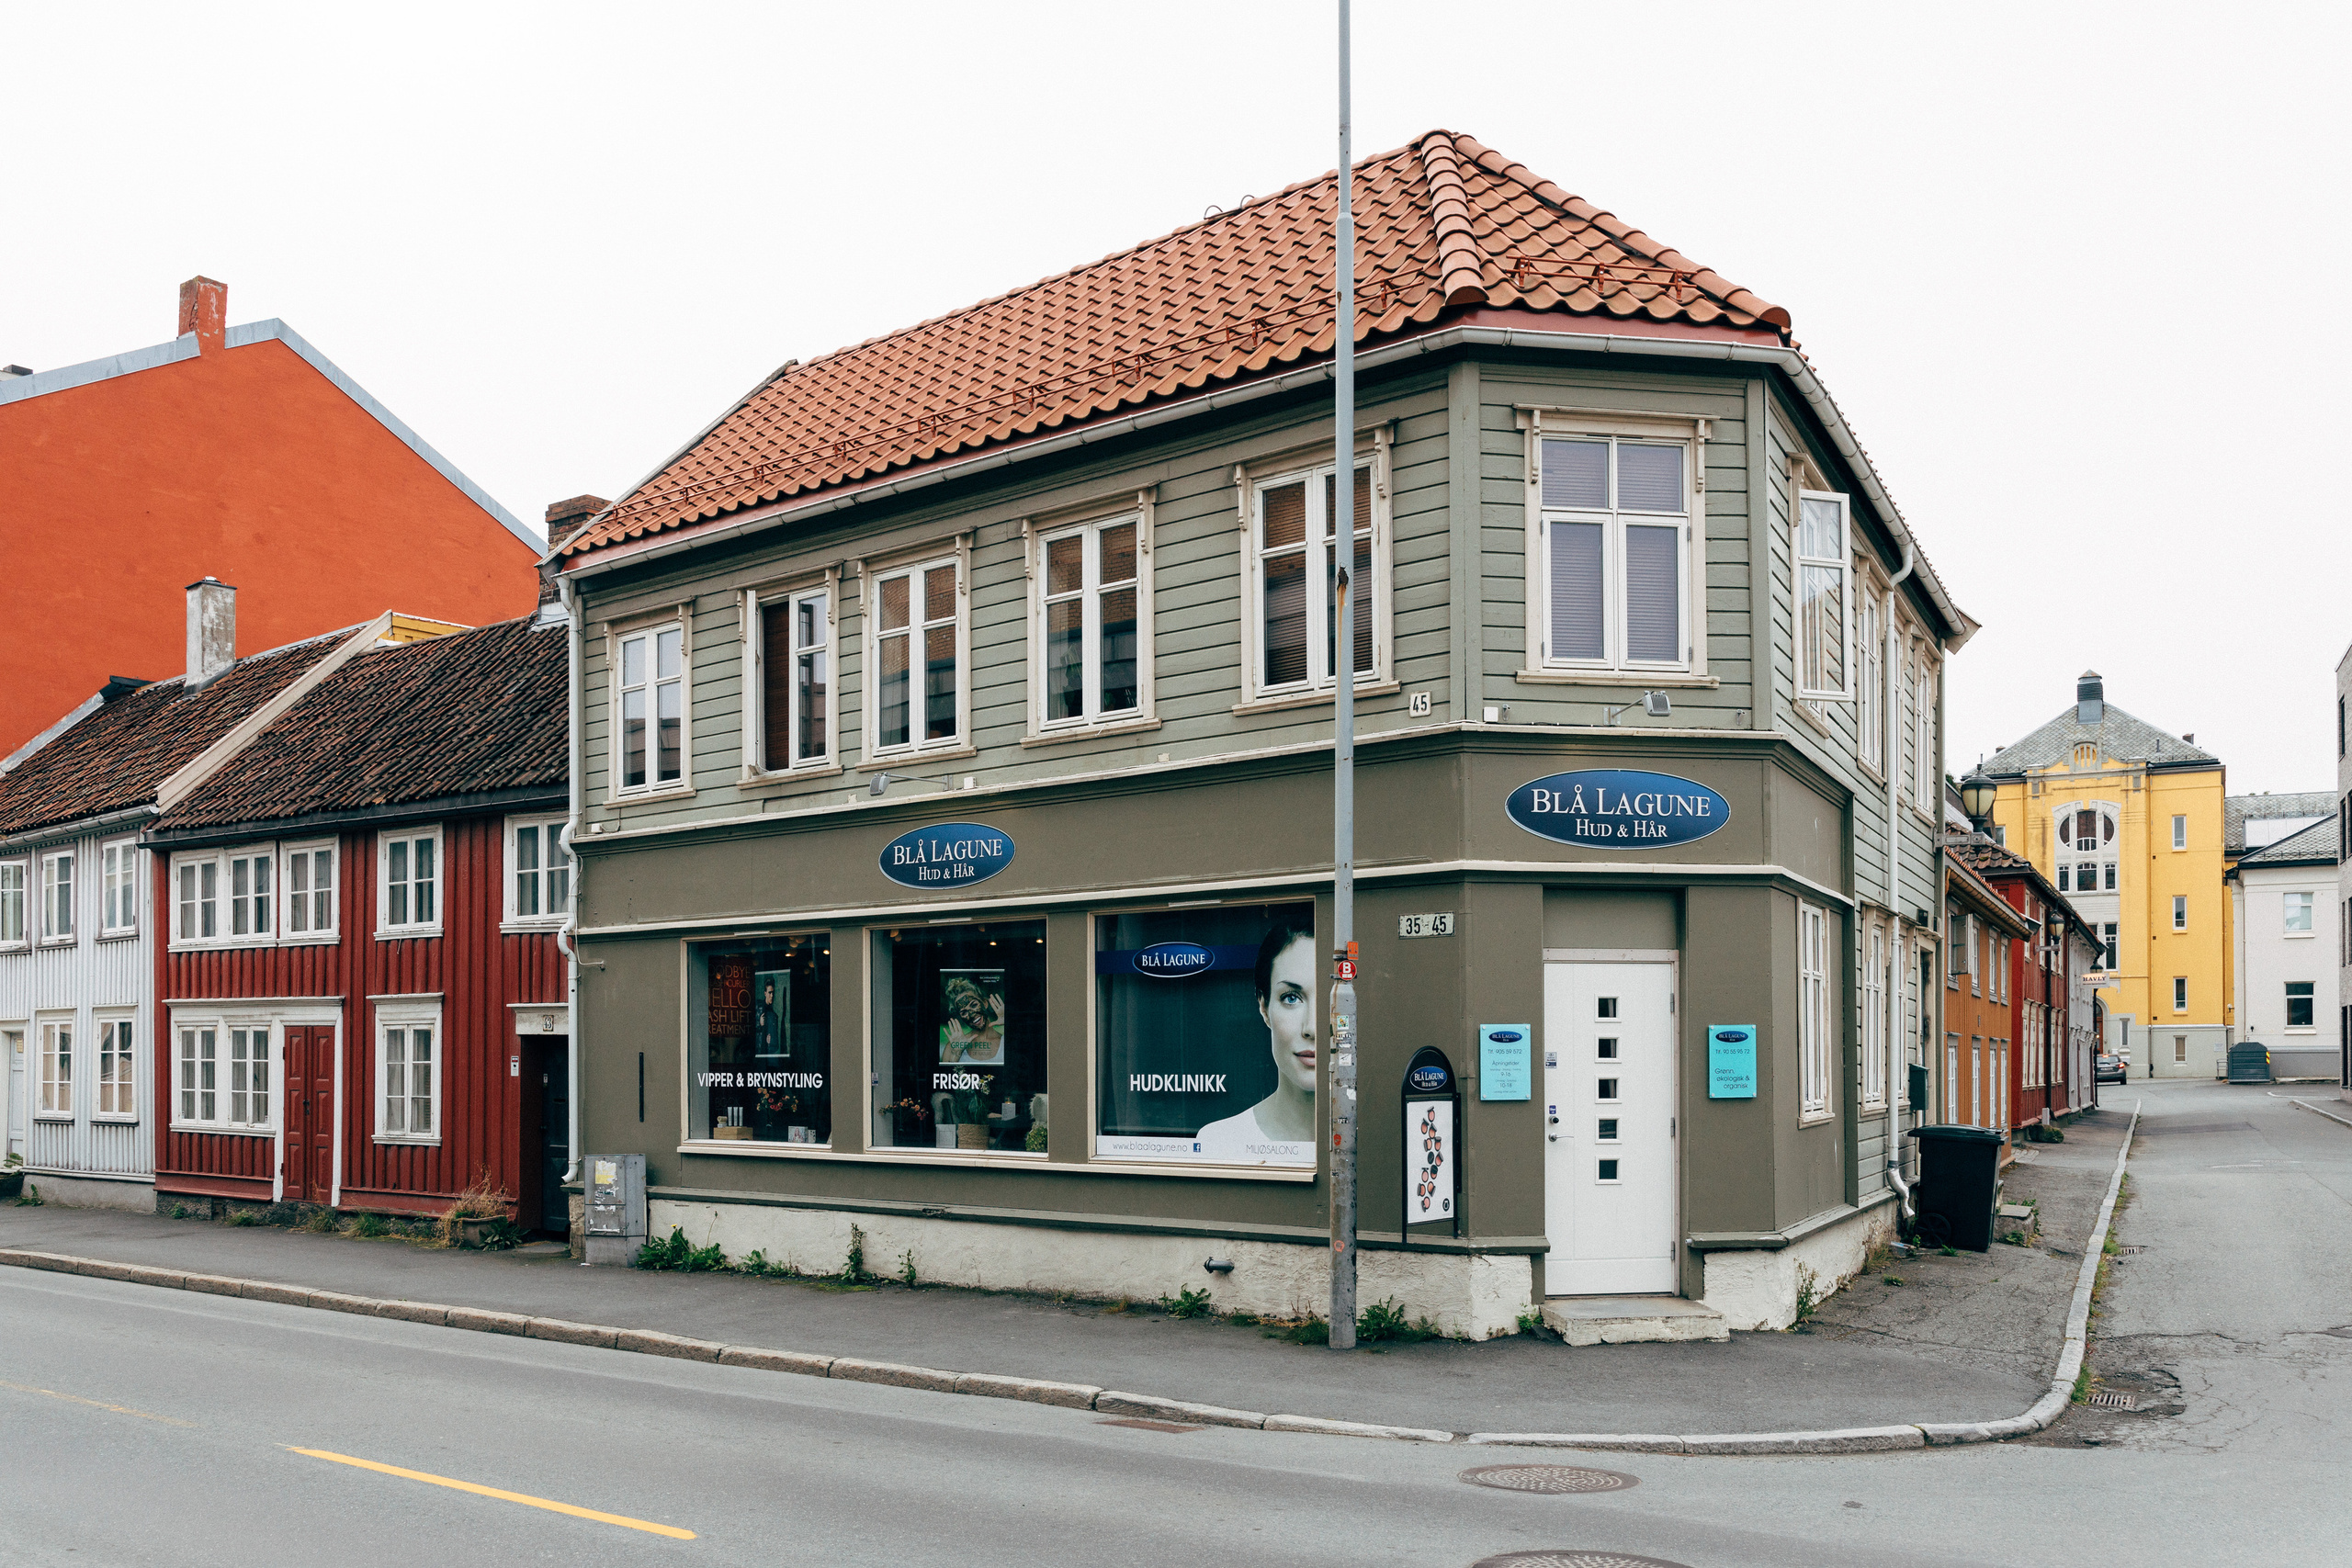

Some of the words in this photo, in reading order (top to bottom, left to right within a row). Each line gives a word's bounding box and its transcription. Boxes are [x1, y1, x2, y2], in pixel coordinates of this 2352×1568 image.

[1413, 694, 1428, 712] 45
[1531, 784, 1589, 815] BLÅ
[1596, 788, 1711, 817] LAGUNE
[1575, 818, 1611, 837] HUD
[1617, 824, 1628, 838] &
[1634, 820, 1668, 838] HÅR
[893, 839, 927, 865] BLÅ
[931, 839, 1003, 863] LAGUNE
[919, 866, 941, 881] HUD
[944, 868, 950, 879] &
[953, 863, 975, 878] HÅR
[1406, 918, 1420, 934] 35
[1432, 915, 1446, 932] 45
[1142, 952, 1160, 967] BLÅ
[1163, 953, 1205, 966] LAGUNE
[1342, 962, 1351, 974] B
[708, 1010, 727, 1023] ASH
[730, 1010, 752, 1023] LIFT
[697, 1072, 733, 1088] VIPPER
[736, 1072, 744, 1088] &
[747, 1072, 823, 1089] BRYNSTYLING
[933, 1073, 980, 1090] FRISØR
[1130, 1074, 1227, 1092] HUDKLINIKK
[1425, 1071, 1444, 1081] LAGUNE
[1113, 1141, 1188, 1153] www.blaalagune.no
